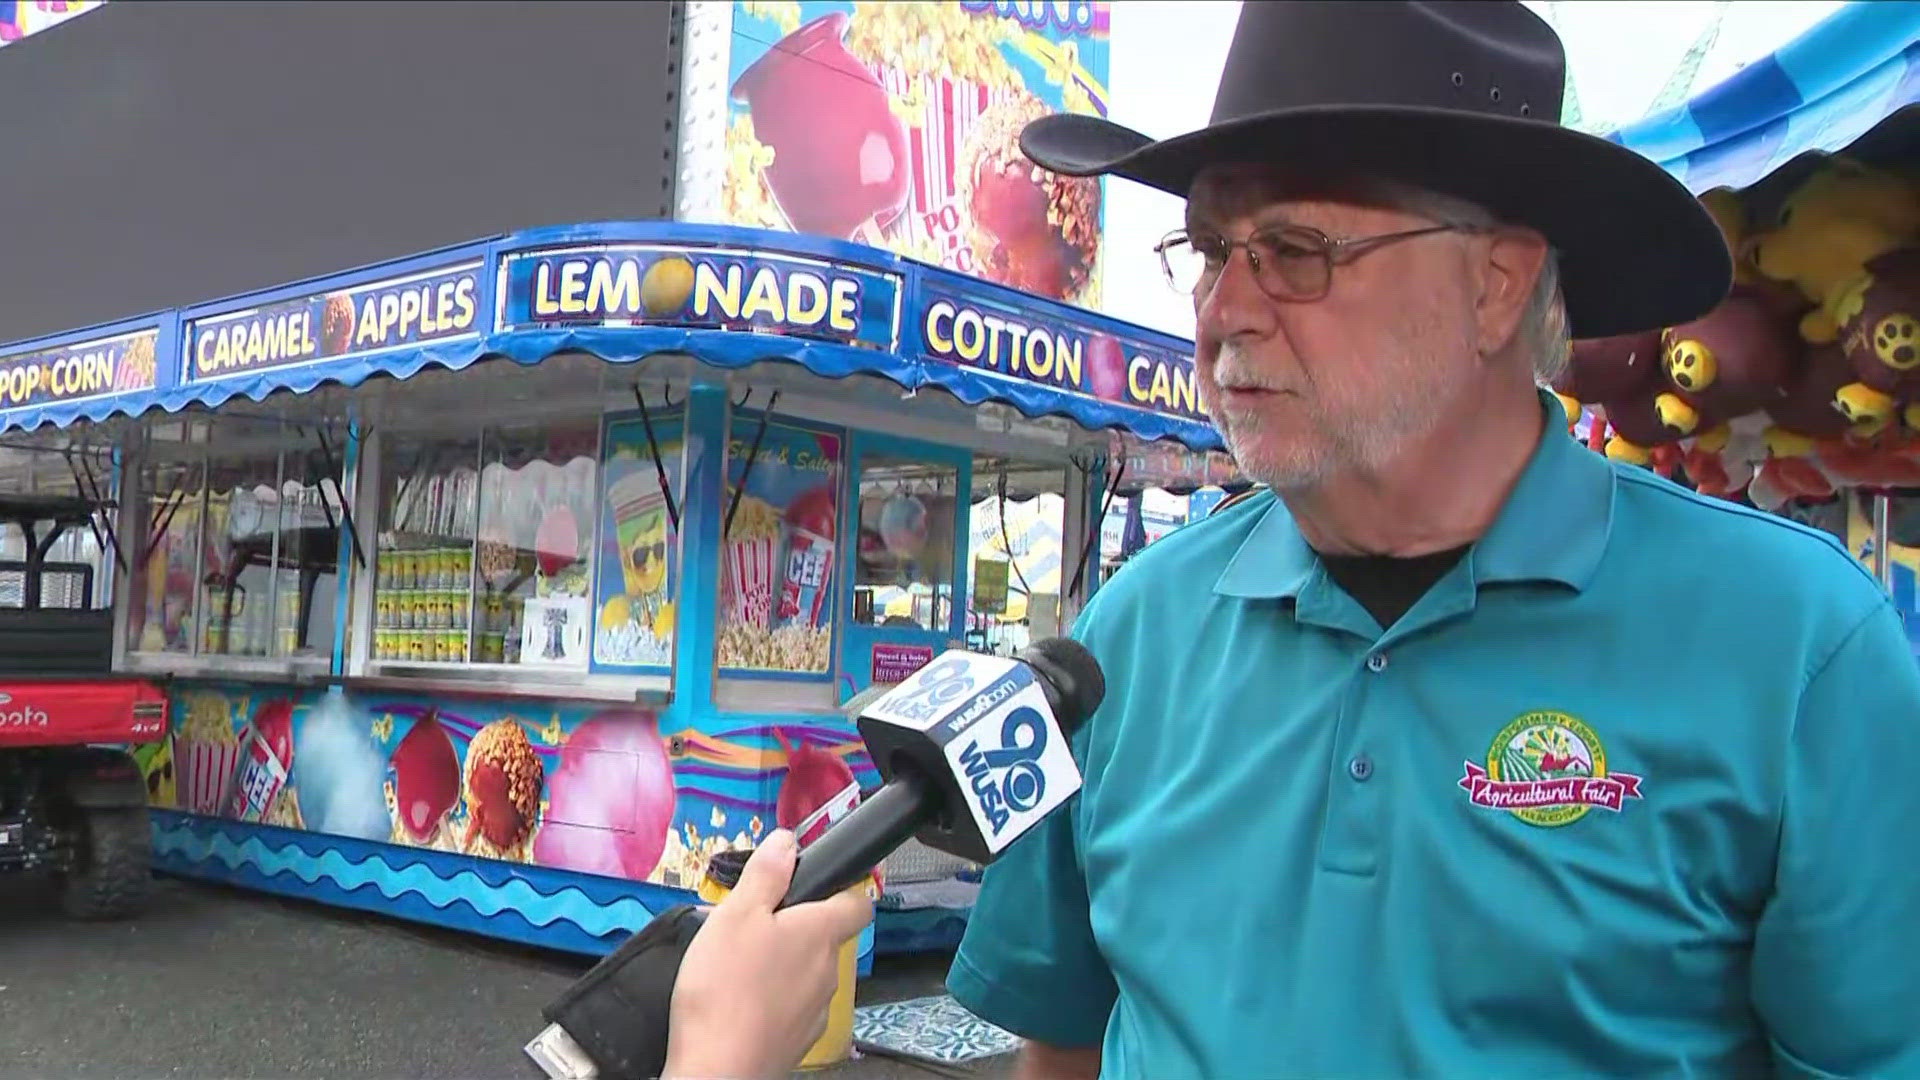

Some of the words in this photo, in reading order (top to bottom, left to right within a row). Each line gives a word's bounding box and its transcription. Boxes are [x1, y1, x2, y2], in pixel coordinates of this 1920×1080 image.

[196, 309, 316, 374] CARAMEL
[355, 276, 476, 345] APPLES
[926, 301, 1084, 387] COTTON
[1128, 354, 1208, 415] CAN
[51, 349, 115, 396] CORN
[132, 722, 160, 732] 4x4
[958, 739, 1011, 837] WUSA
[1476, 782, 1574, 807] Agricultural
[1580, 779, 1616, 805] Fair
